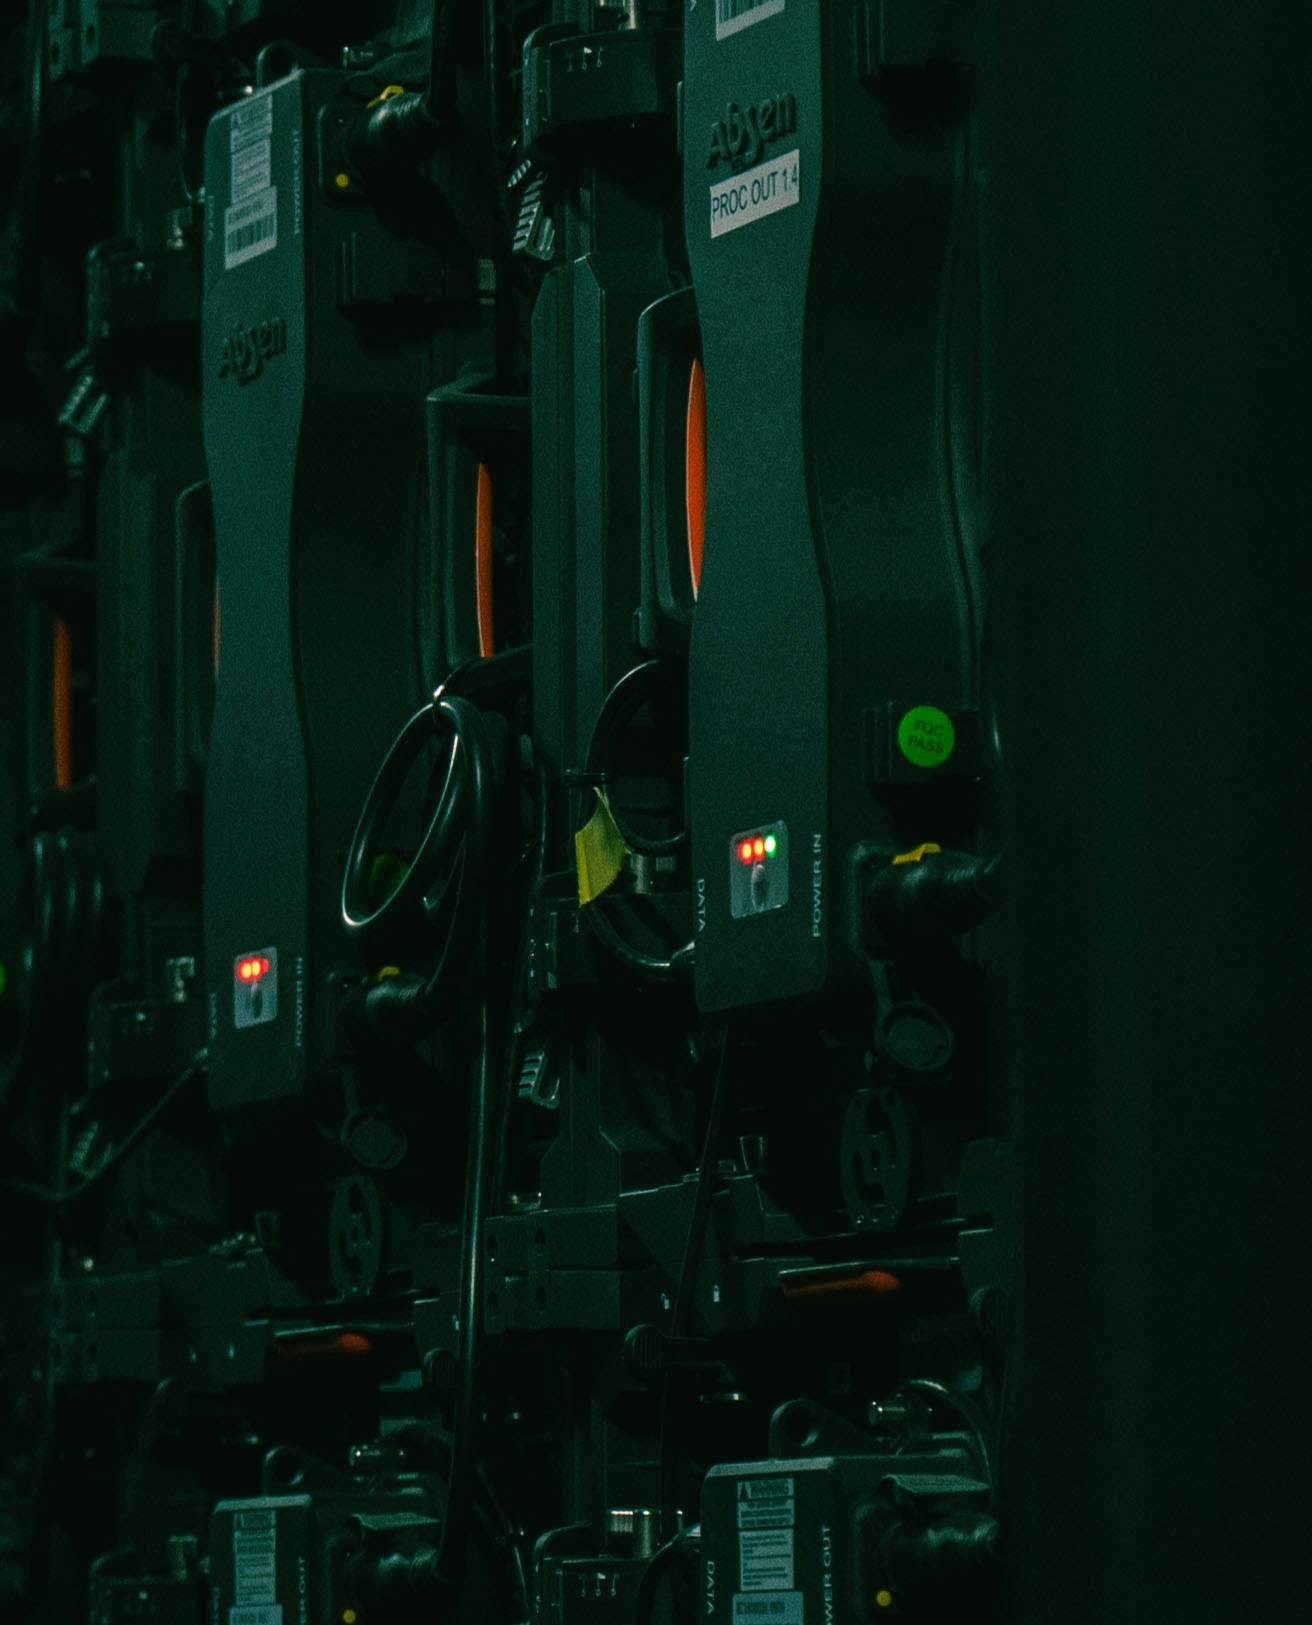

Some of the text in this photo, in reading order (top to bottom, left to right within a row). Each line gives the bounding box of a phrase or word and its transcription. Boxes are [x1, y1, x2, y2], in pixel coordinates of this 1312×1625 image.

[706, 92, 796, 169] Absen
[712, 164, 798, 222] PROC OUT 1.4
[908, 735, 944, 754] PASS
[697, 878, 707, 933] DATA
[812, 833, 822, 938] POWER IN
[821, 1522, 832, 1568] OUT
[706, 1560, 715, 1615] DATA
